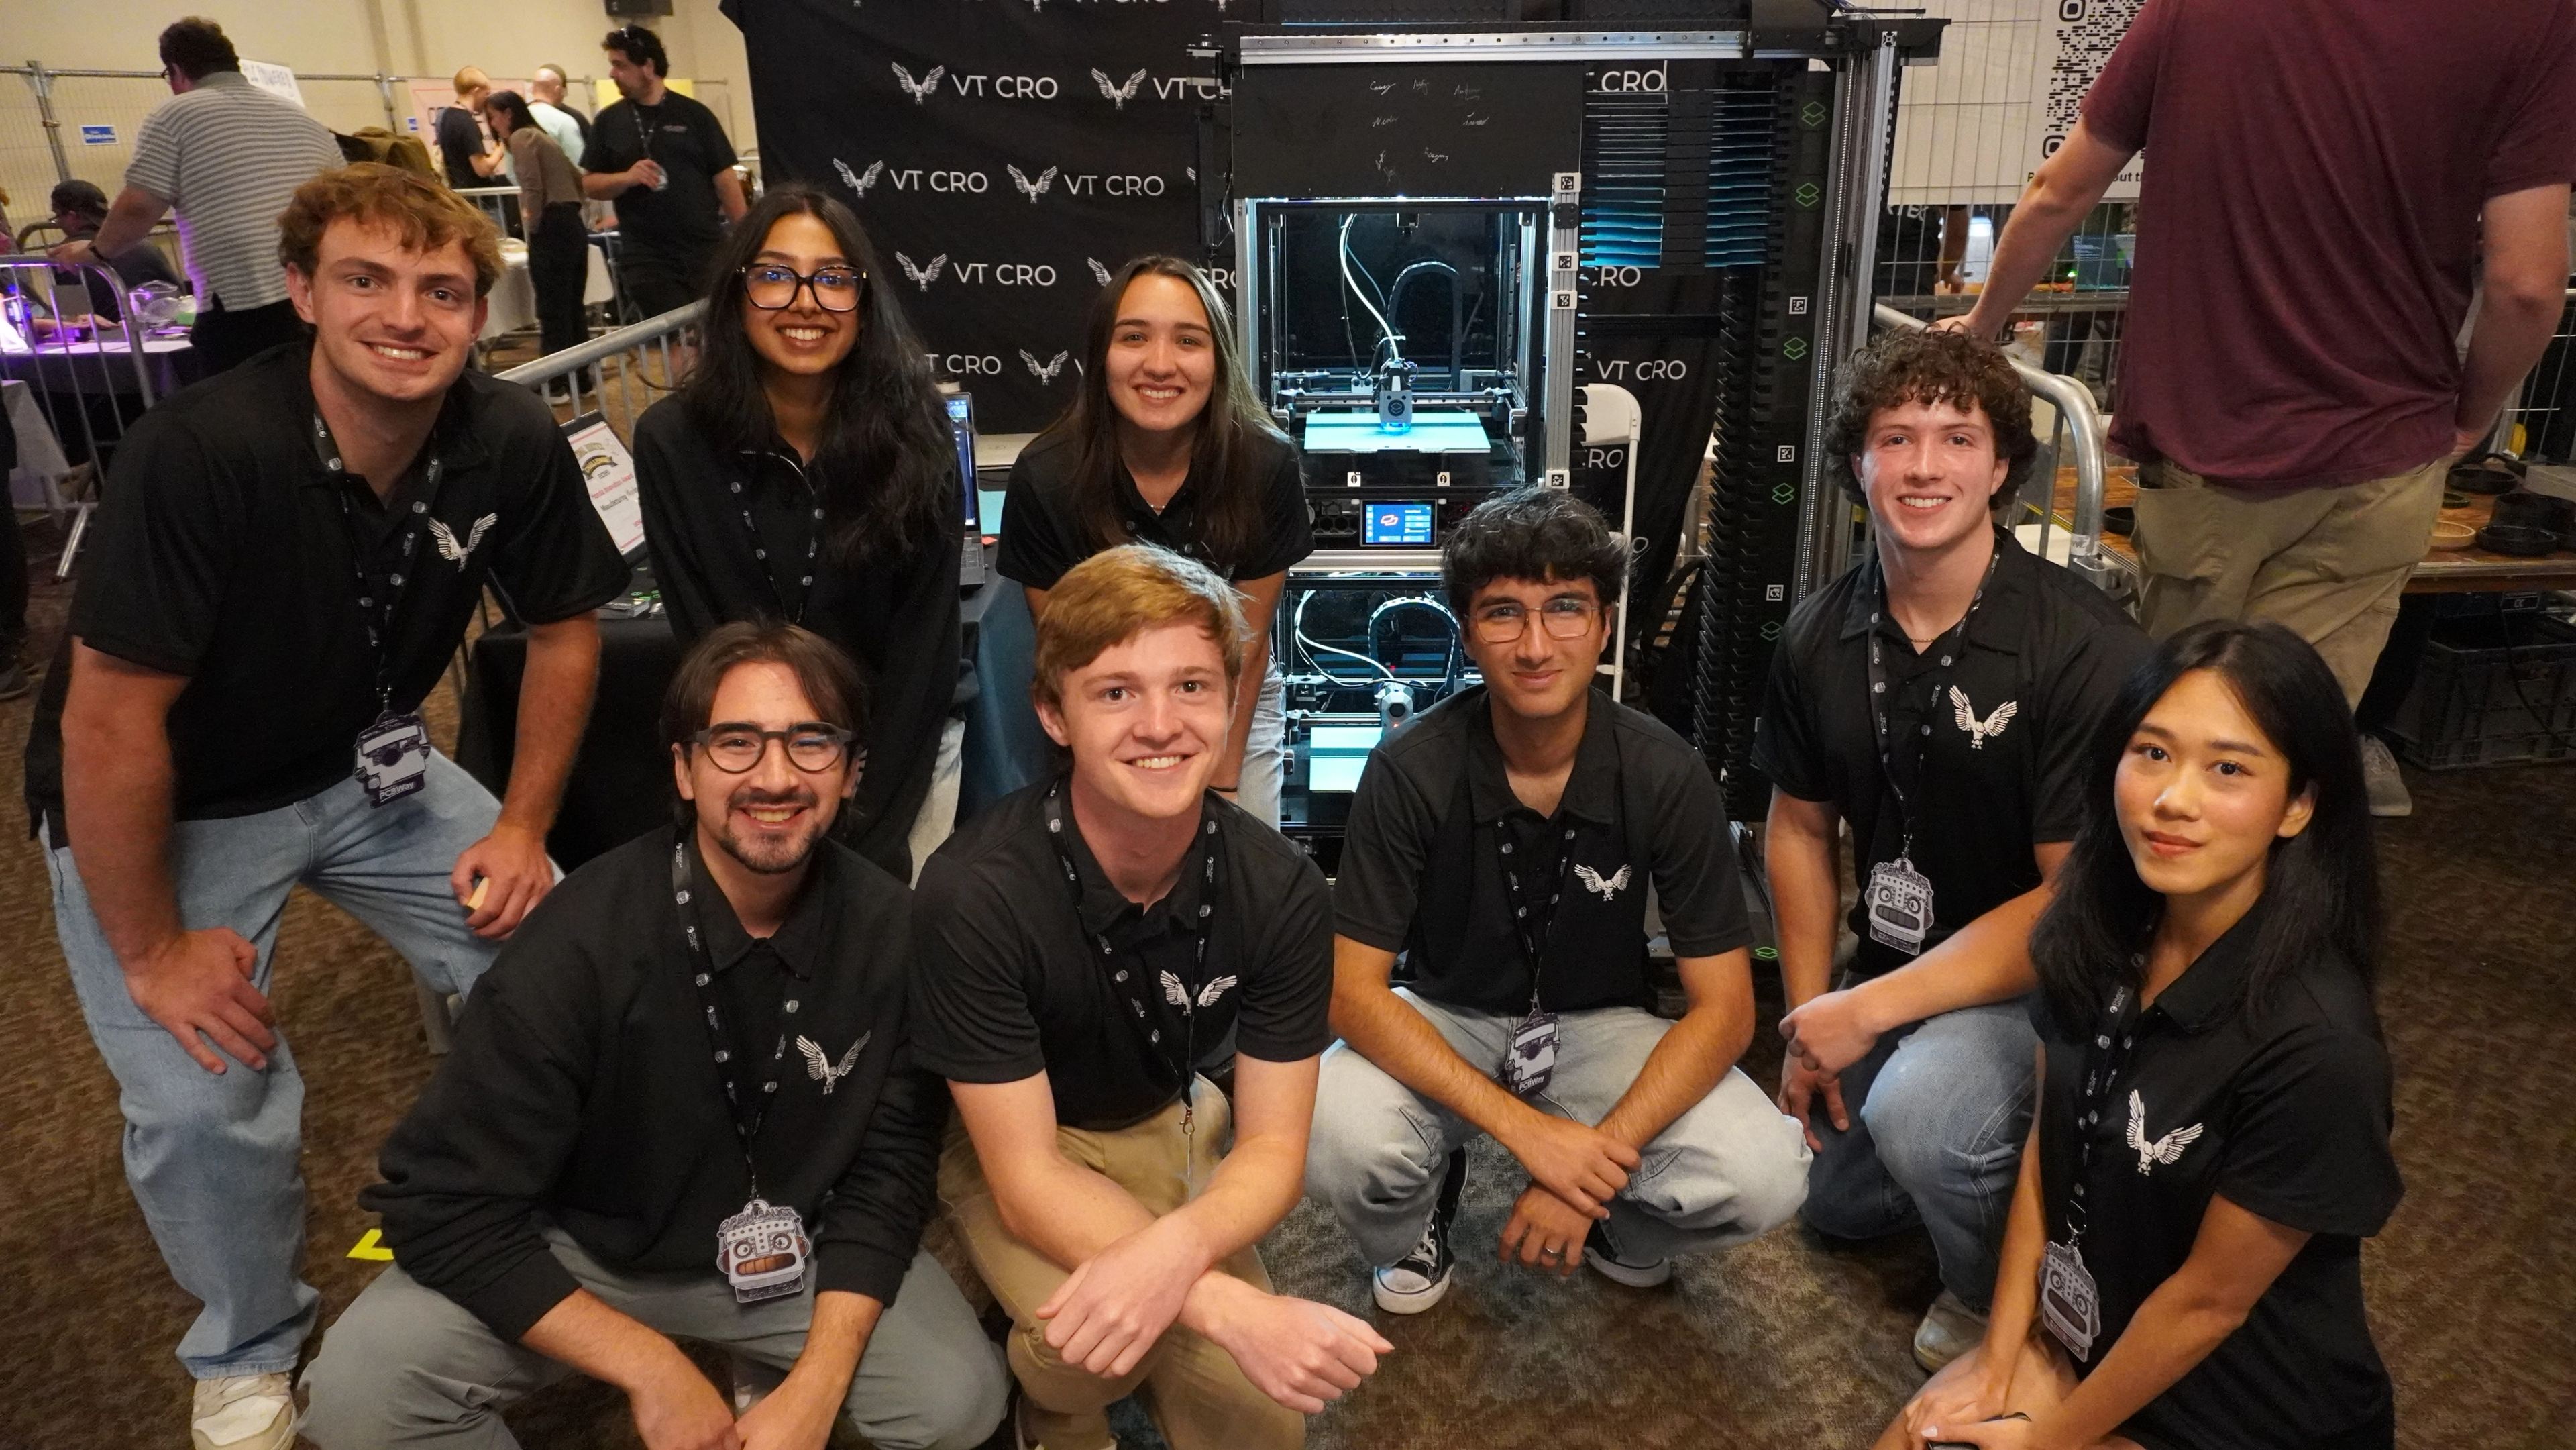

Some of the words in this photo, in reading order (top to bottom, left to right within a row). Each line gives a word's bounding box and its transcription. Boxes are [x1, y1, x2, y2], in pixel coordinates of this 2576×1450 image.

[952, 74, 987, 96] VT
[996, 76, 1058, 99] CRO
[1153, 77, 1187, 99] VT
[1601, 70, 1664, 92] CRO
[890, 170, 923, 190] VT
[930, 171, 987, 193] CRO
[1064, 175, 1097, 195] VT
[1106, 176, 1164, 195] CRO
[954, 263, 988, 283] VT
[996, 264, 1056, 286] CRO
[924, 354, 939, 372] T
[946, 354, 1001, 374] CRO
[1597, 360, 1629, 380] VT
[1636, 360, 1686, 380] CRO
[1582, 448, 1623, 469] RO
[1519, 1076, 1545, 1090] PCBWay
